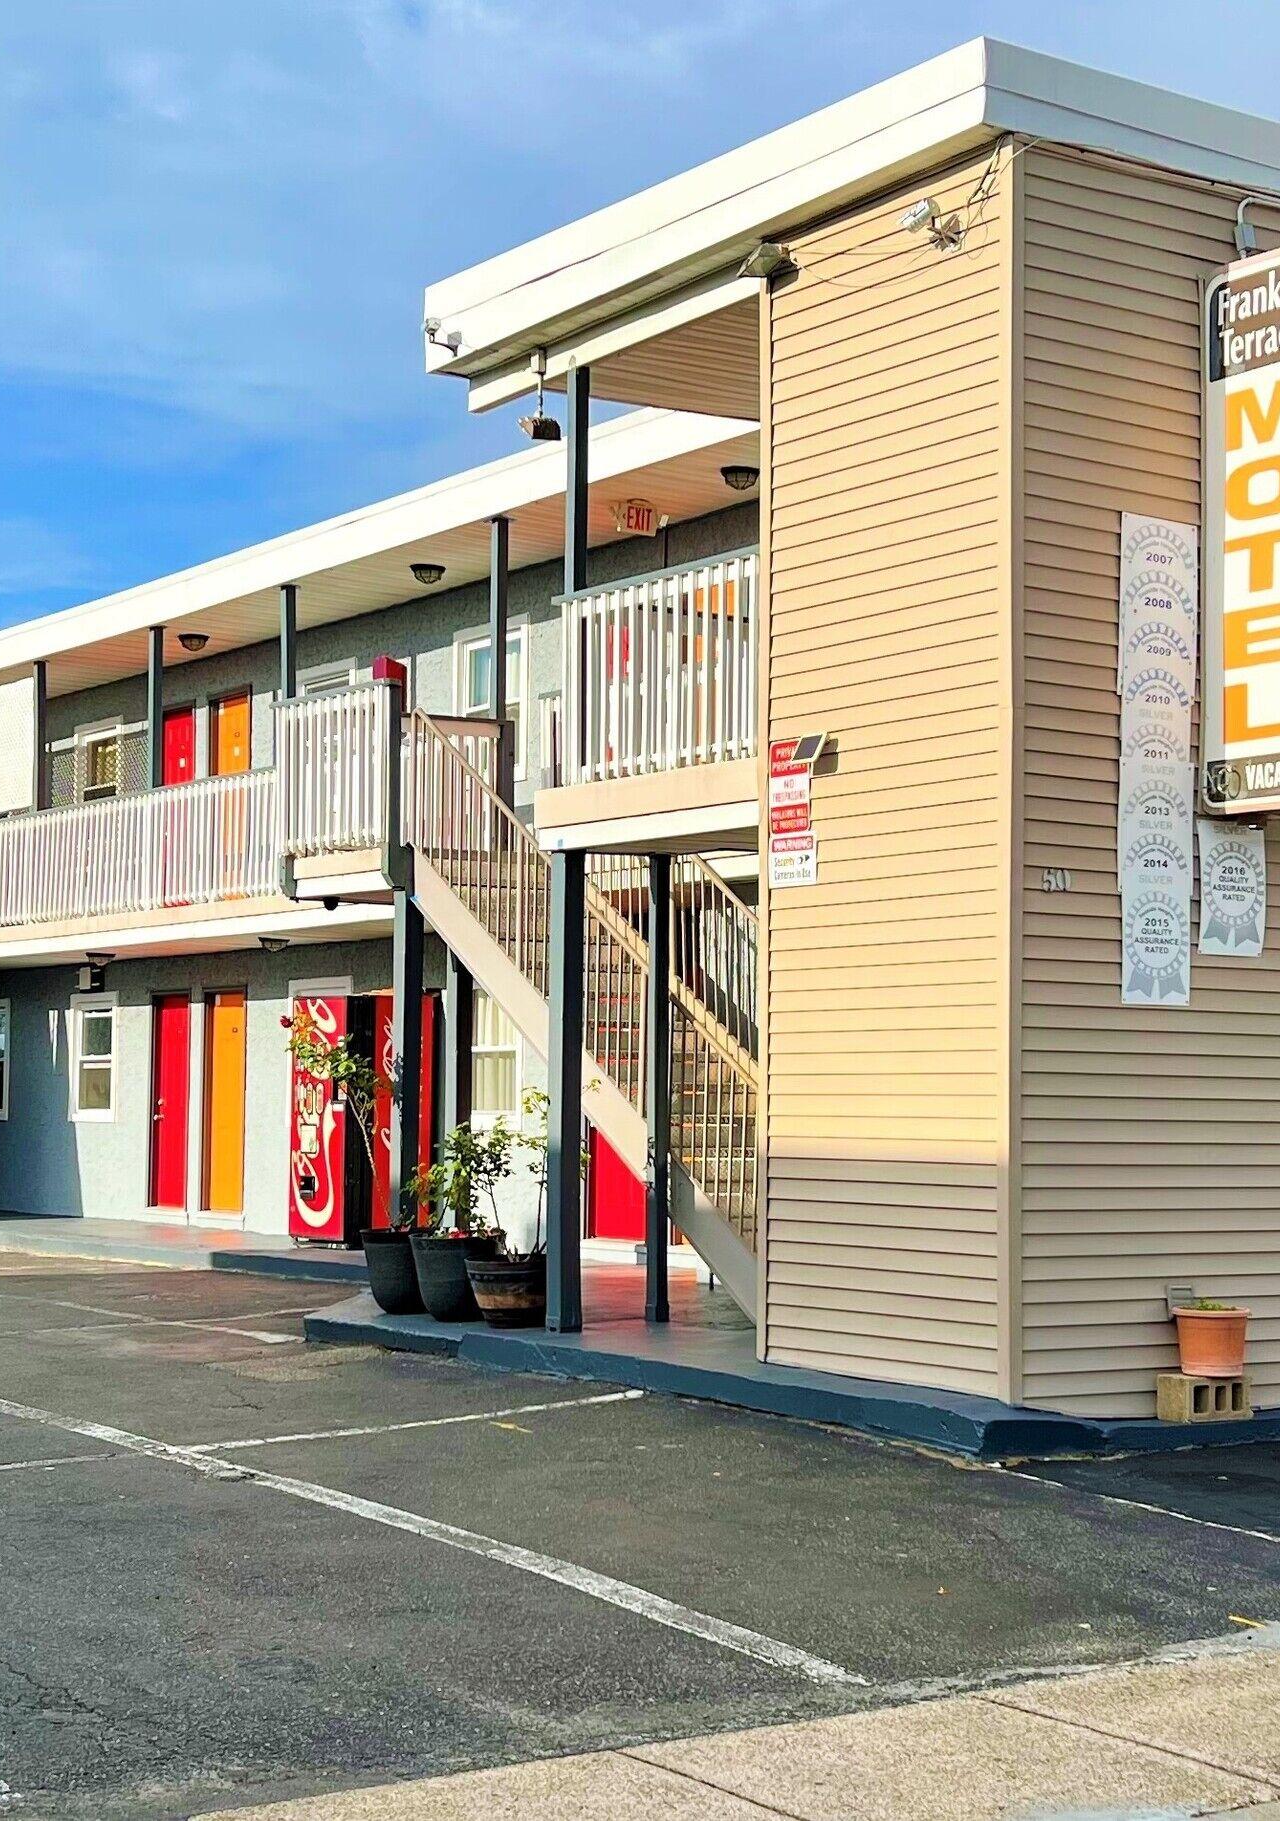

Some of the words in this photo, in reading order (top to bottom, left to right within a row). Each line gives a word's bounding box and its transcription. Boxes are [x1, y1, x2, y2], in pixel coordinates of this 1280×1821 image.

[626, 505, 652, 532] EXIT
[1146, 552, 1173, 566] 2007
[1145, 597, 1172, 609] 2008
[1146, 645, 1171, 656] 2009
[1145, 694, 1171, 705] 2010
[1144, 749, 1169, 760] 2011
[784, 779, 794, 788] NO
[1144, 806, 1169, 816] 2013
[774, 837, 812, 851] WARNING
[1144, 859, 1168, 868] 2014
[1222, 866, 1246, 875] 2016
[1043, 869, 1071, 892] 50
[1219, 875, 1249, 884] QUALITY
[1213, 884, 1256, 894] ASSURANCE
[1222, 893, 1246, 902] RATED
[1145, 918, 1169, 928] 2015
[1141, 928, 1173, 936] QUALITY
[1134, 937, 1179, 946] ASSURANCE
[1145, 946, 1169, 954] RATED
